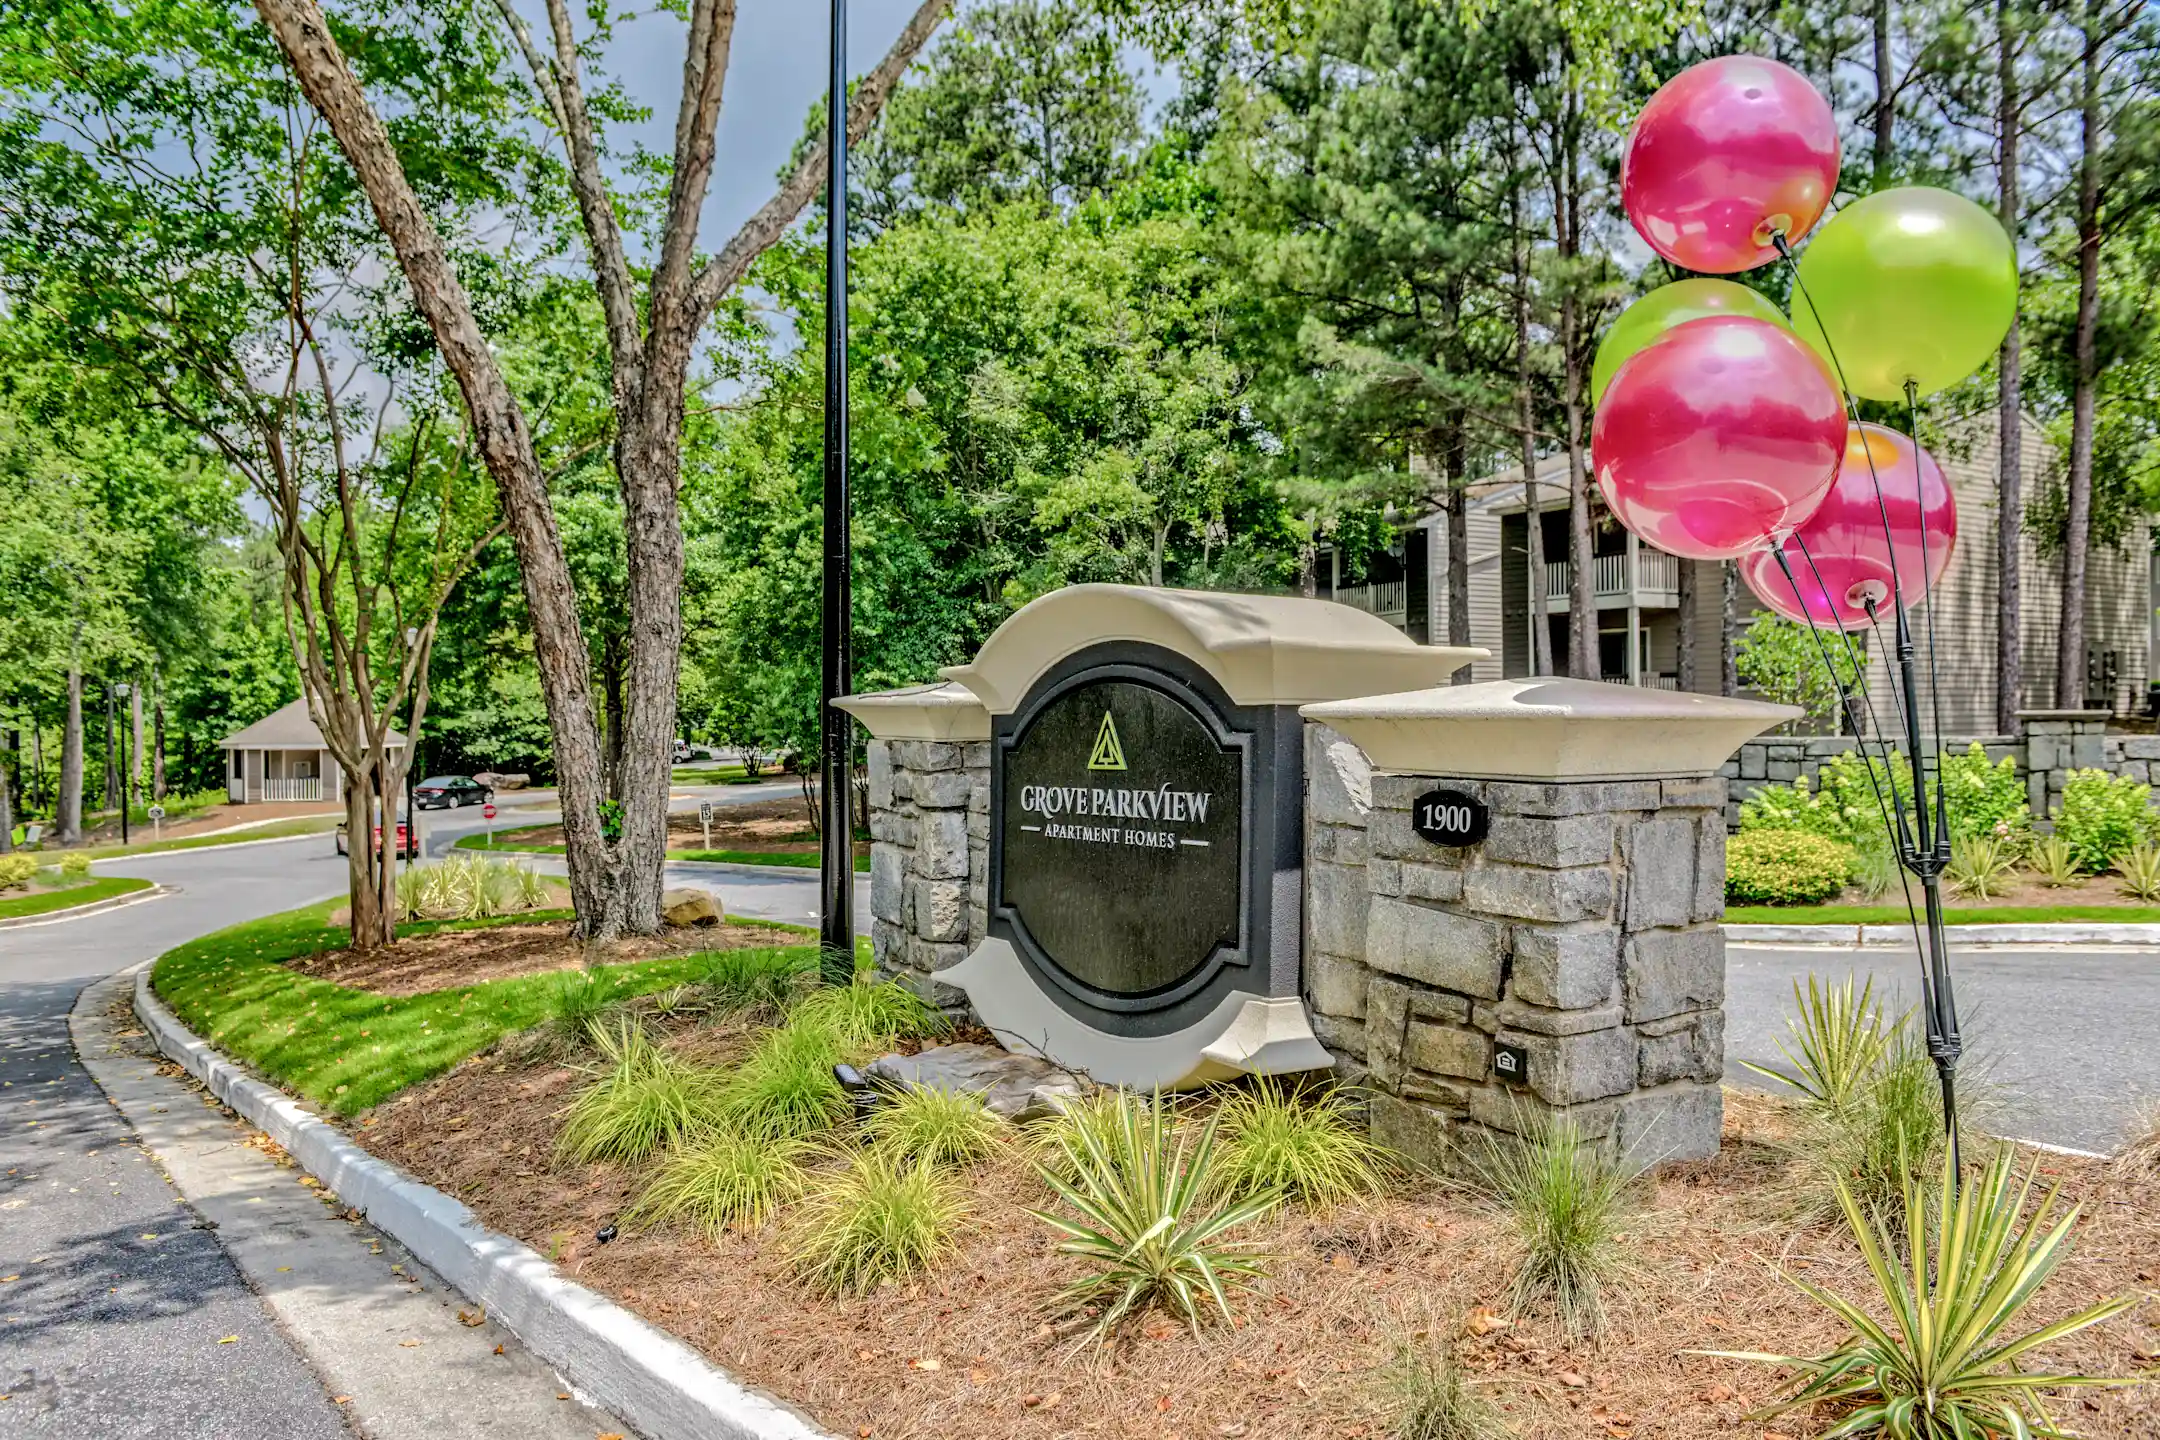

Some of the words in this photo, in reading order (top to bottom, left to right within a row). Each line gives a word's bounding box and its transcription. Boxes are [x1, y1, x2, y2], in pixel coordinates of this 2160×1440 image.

[1020, 785, 1088, 819] GROVE
[1092, 781, 1212, 823] PARKVIEW
[1422, 803, 1472, 833] 1900
[1044, 823, 1120, 844] APARTMENT
[1124, 829, 1176, 849] HOMES
